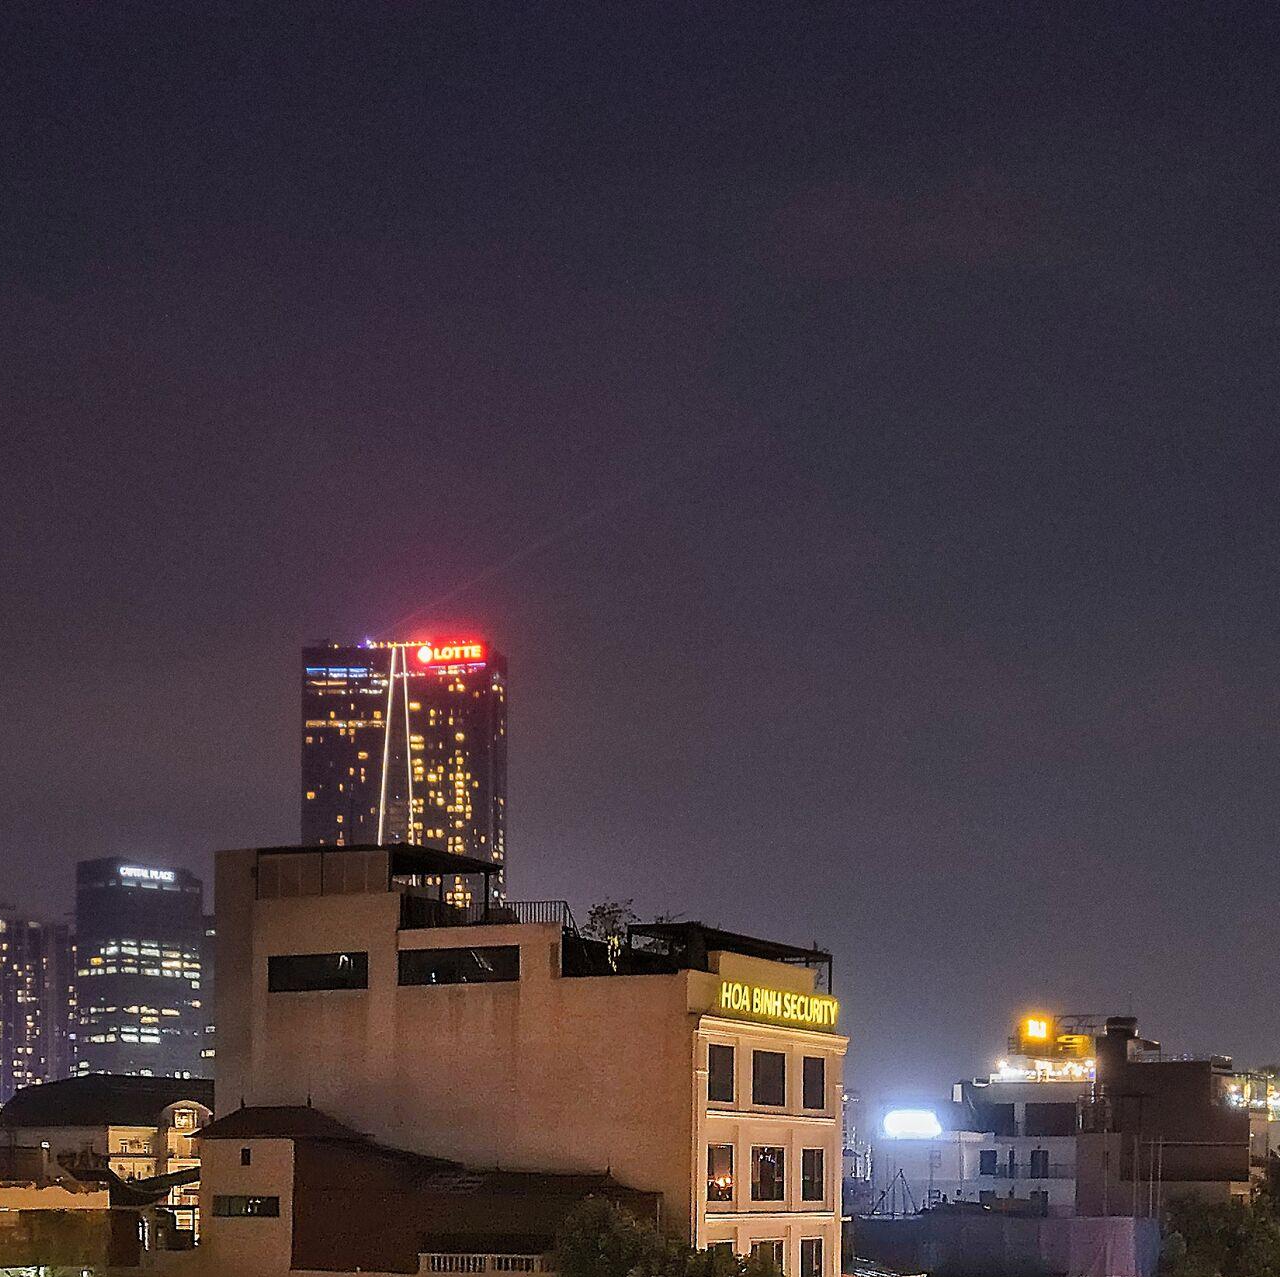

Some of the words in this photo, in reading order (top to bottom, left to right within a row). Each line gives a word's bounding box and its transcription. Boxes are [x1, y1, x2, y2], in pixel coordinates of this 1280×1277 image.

[433, 645, 481, 660] LOTTE
[721, 981, 751, 1012] HOA
[752, 987, 782, 1018] BINH
[782, 992, 838, 1025] SECURITY
